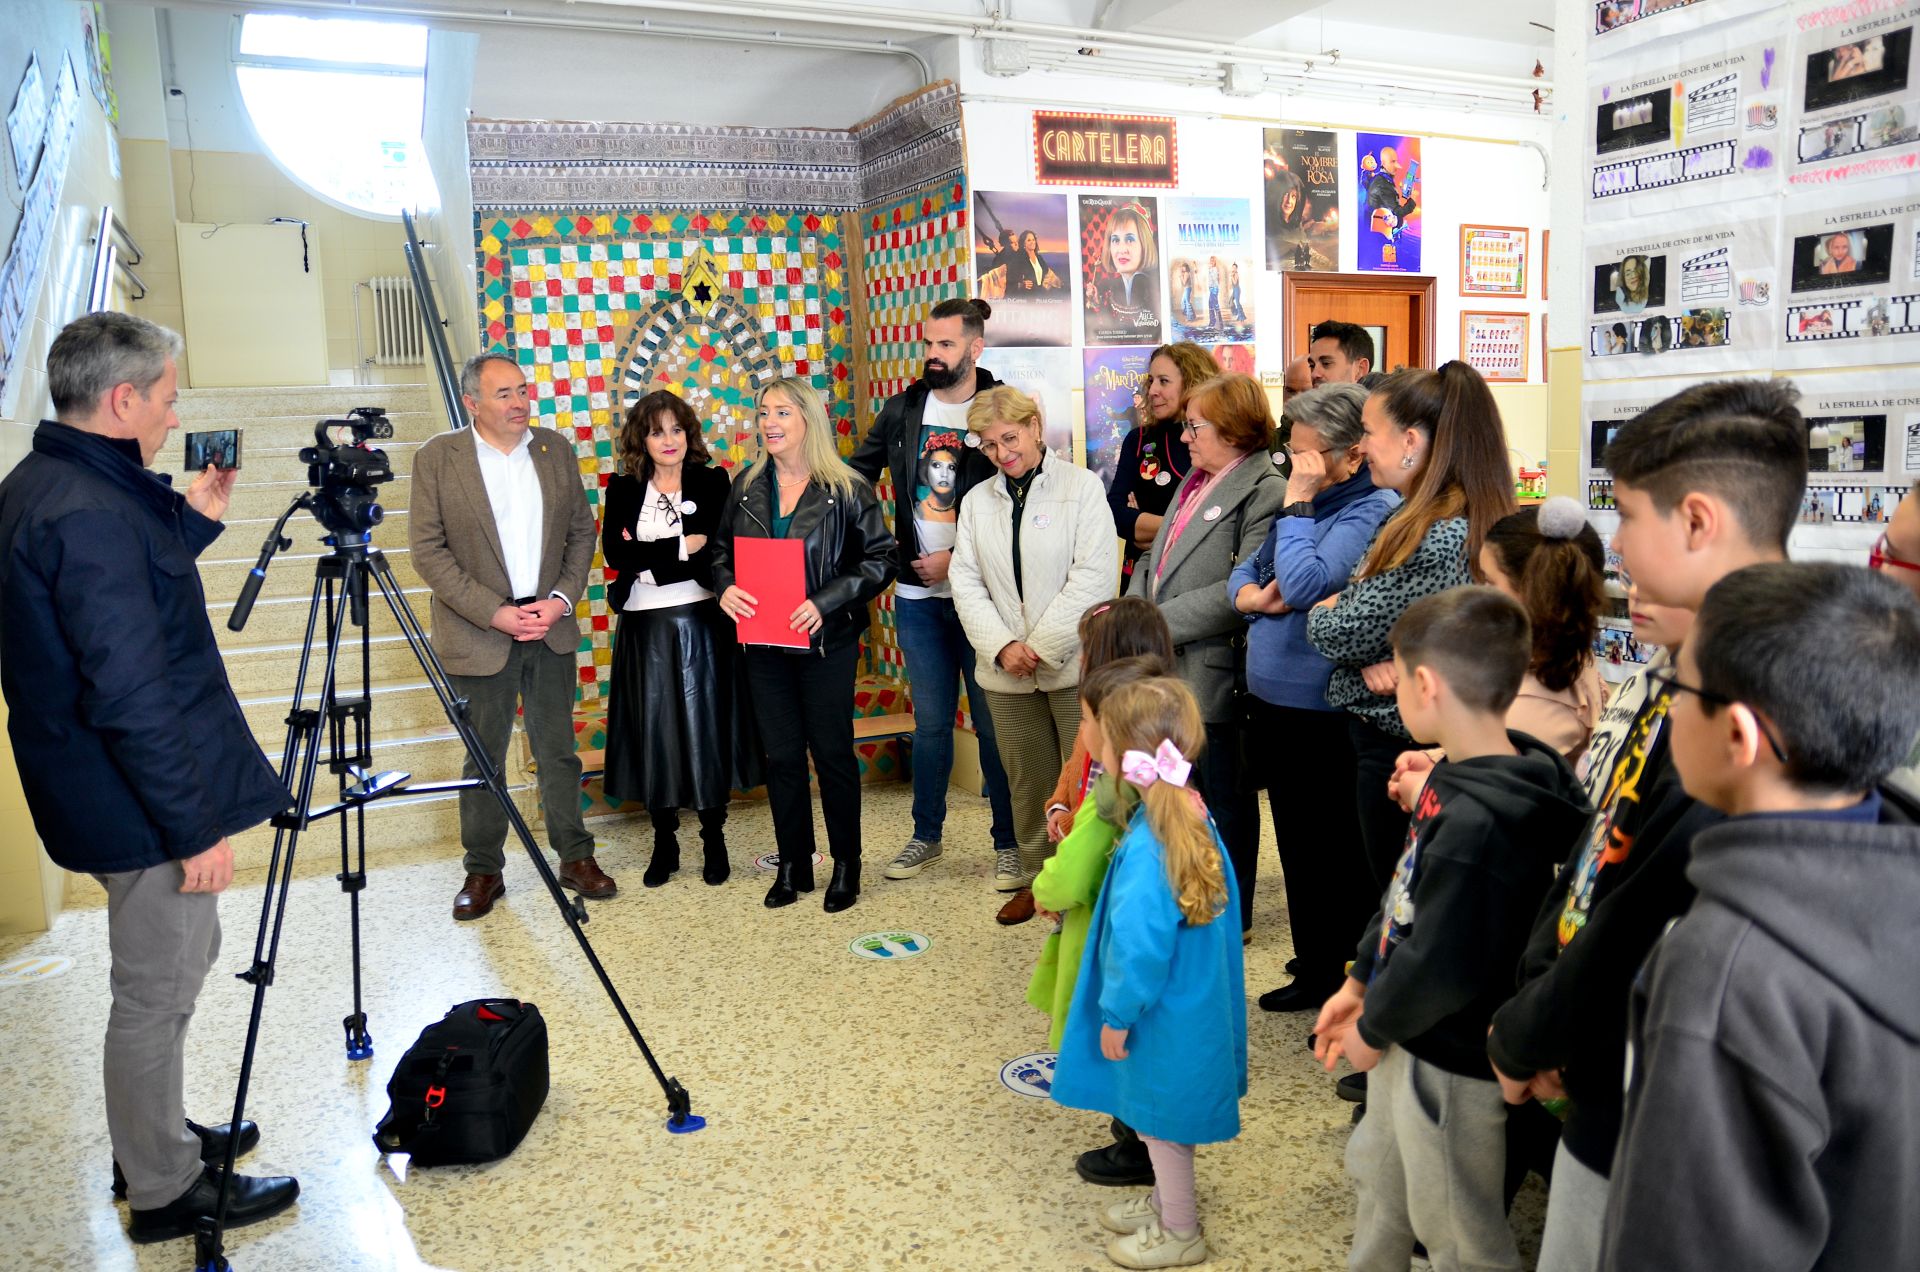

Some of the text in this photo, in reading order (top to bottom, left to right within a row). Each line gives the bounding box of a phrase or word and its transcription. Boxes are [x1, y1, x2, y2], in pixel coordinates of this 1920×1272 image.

[1841, 28, 1853, 37] LA
[1856, 12, 1906, 32] ESTRELLA
[1620, 55, 1746, 93] LA ESTRELLA DE CINE DE MI VIDA
[1042, 130, 1166, 165] CARTELERA
[1301, 156, 1338, 168] NOMBRE
[1307, 170, 1335, 184] ROSA
[1840, 208, 1887, 222] ESTRELLA
[1890, 206, 1904, 215] DE
[1178, 224, 1216, 241] MAMMA
[1626, 243, 1661, 254] ESTRELLA
[1673, 238, 1692, 246] CINE
[1715, 231, 1735, 239] VIDA
[1833, 400, 1879, 409] ESTRELLA
